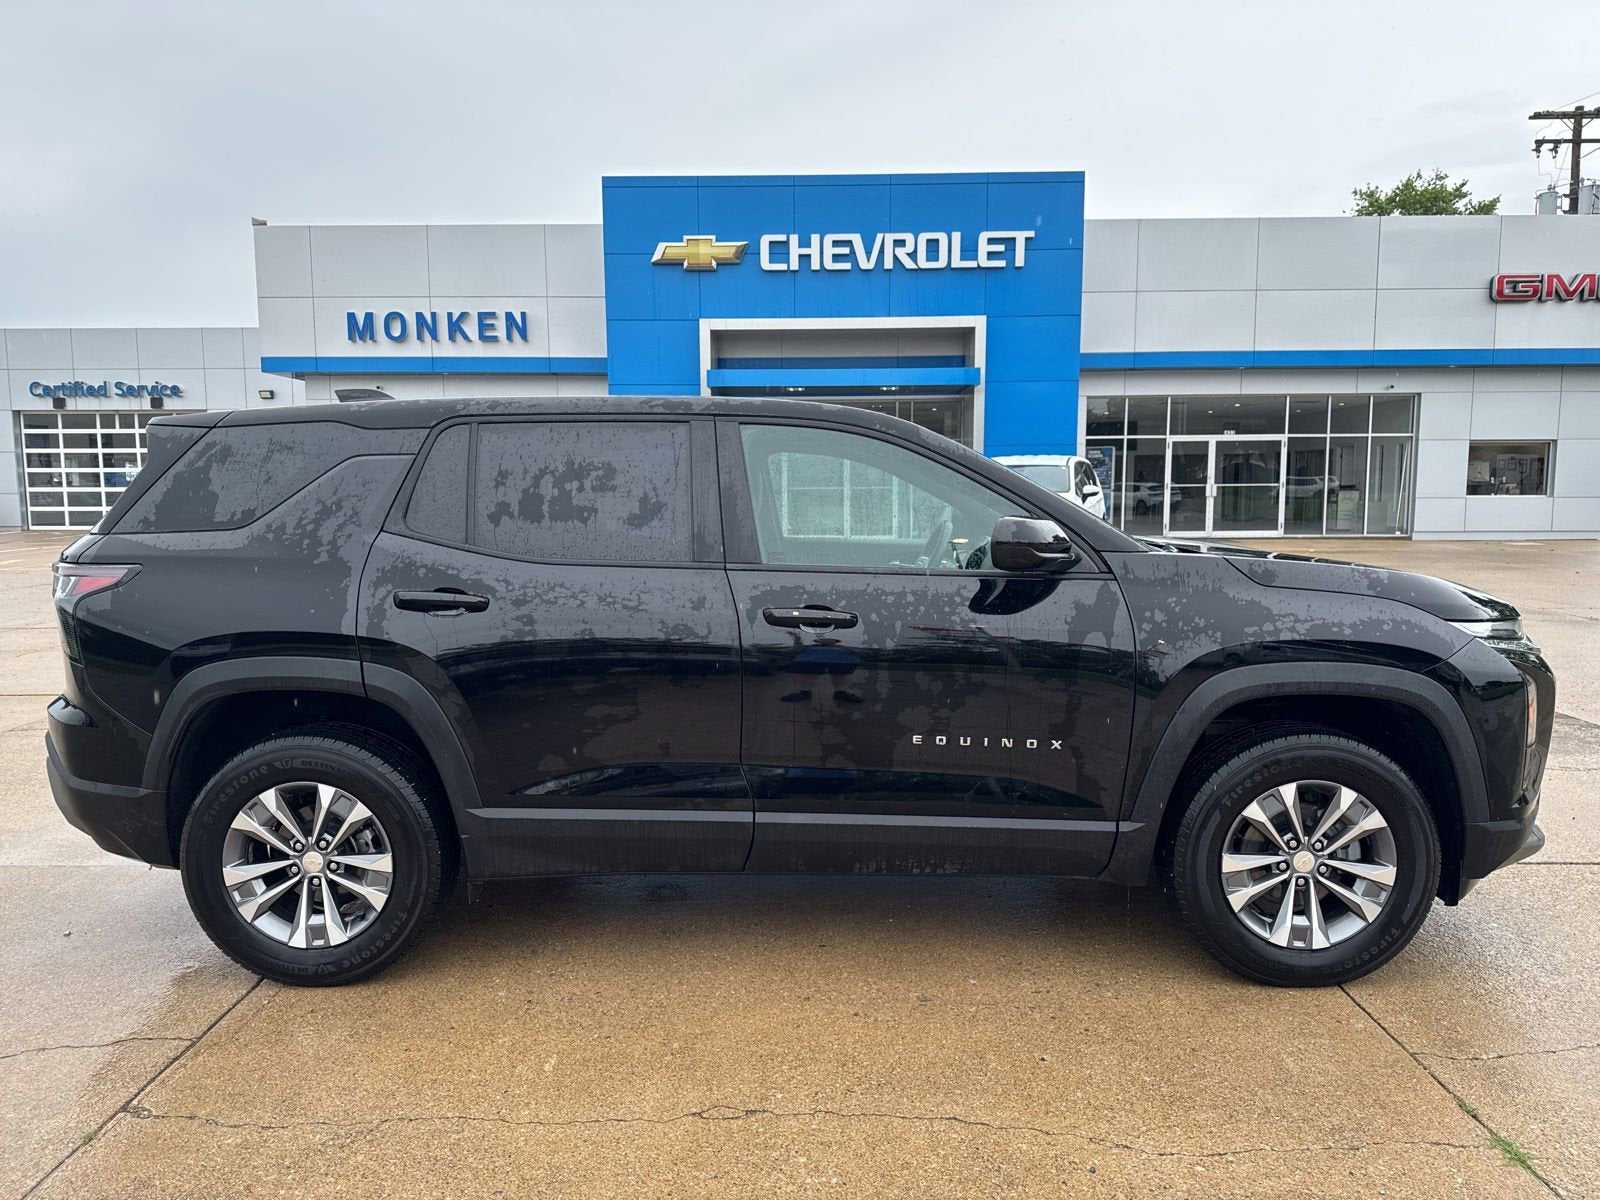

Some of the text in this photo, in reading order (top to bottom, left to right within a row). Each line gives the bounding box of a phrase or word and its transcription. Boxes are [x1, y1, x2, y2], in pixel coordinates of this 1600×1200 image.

[759, 230, 1035, 271] CHEVROLET
[1490, 272, 1600, 302] GM
[346, 311, 529, 343] MONKEN
[29, 380, 183, 398] Certified Service
[912, 734, 1063, 750] EQUINOX
[203, 763, 269, 824] Firestone
[342, 911, 408, 967] Firestone
